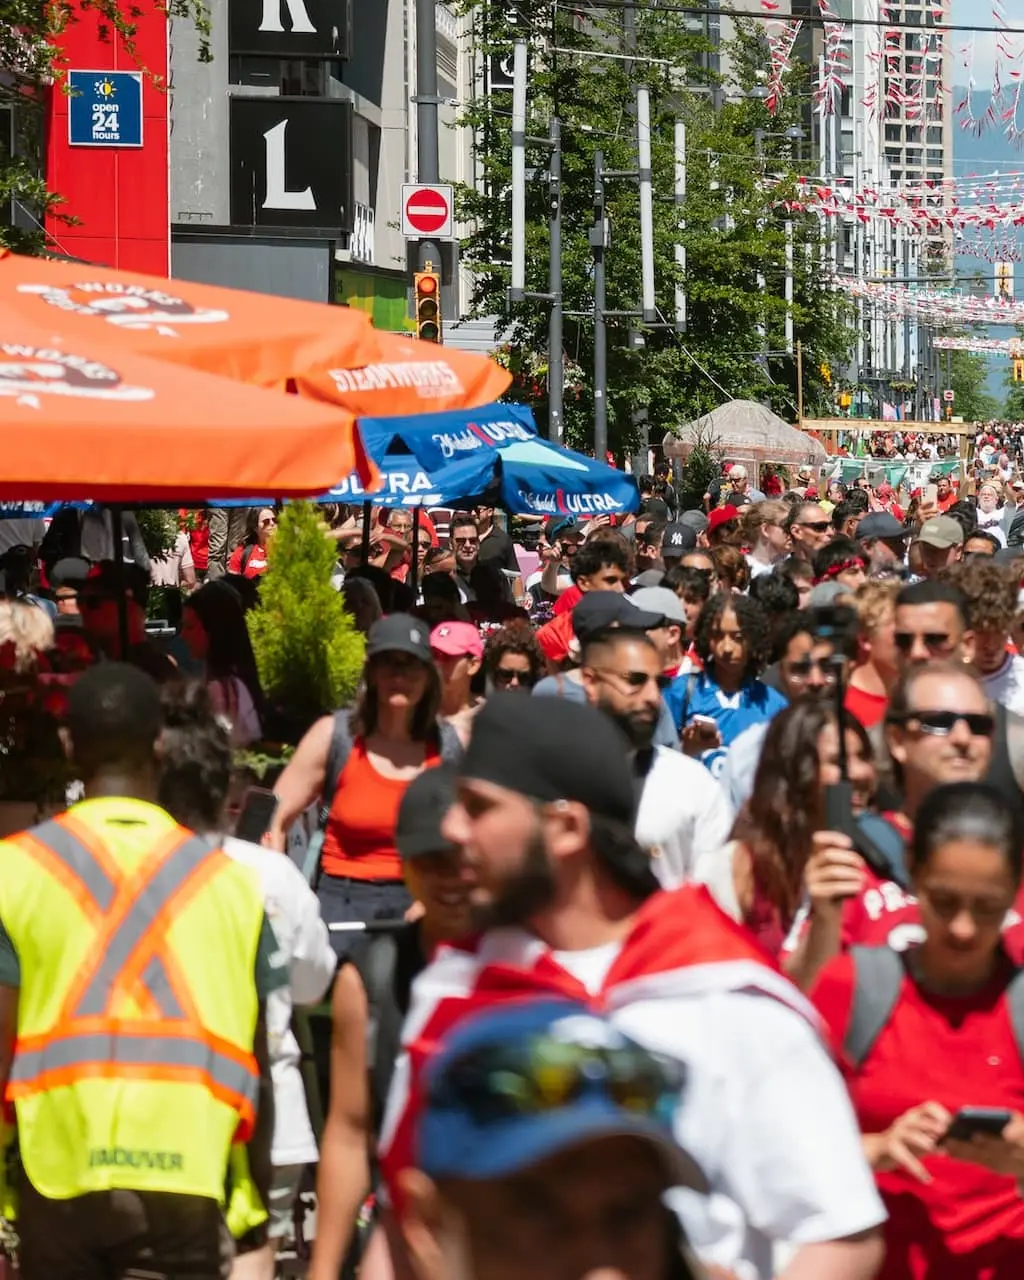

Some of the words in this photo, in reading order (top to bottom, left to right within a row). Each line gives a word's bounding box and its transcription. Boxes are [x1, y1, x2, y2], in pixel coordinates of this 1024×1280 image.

[92, 103, 119, 112] open
[92, 112, 119, 132] 24
[92, 130, 120, 140] hours
[566, 493, 624, 512] ULTRA
